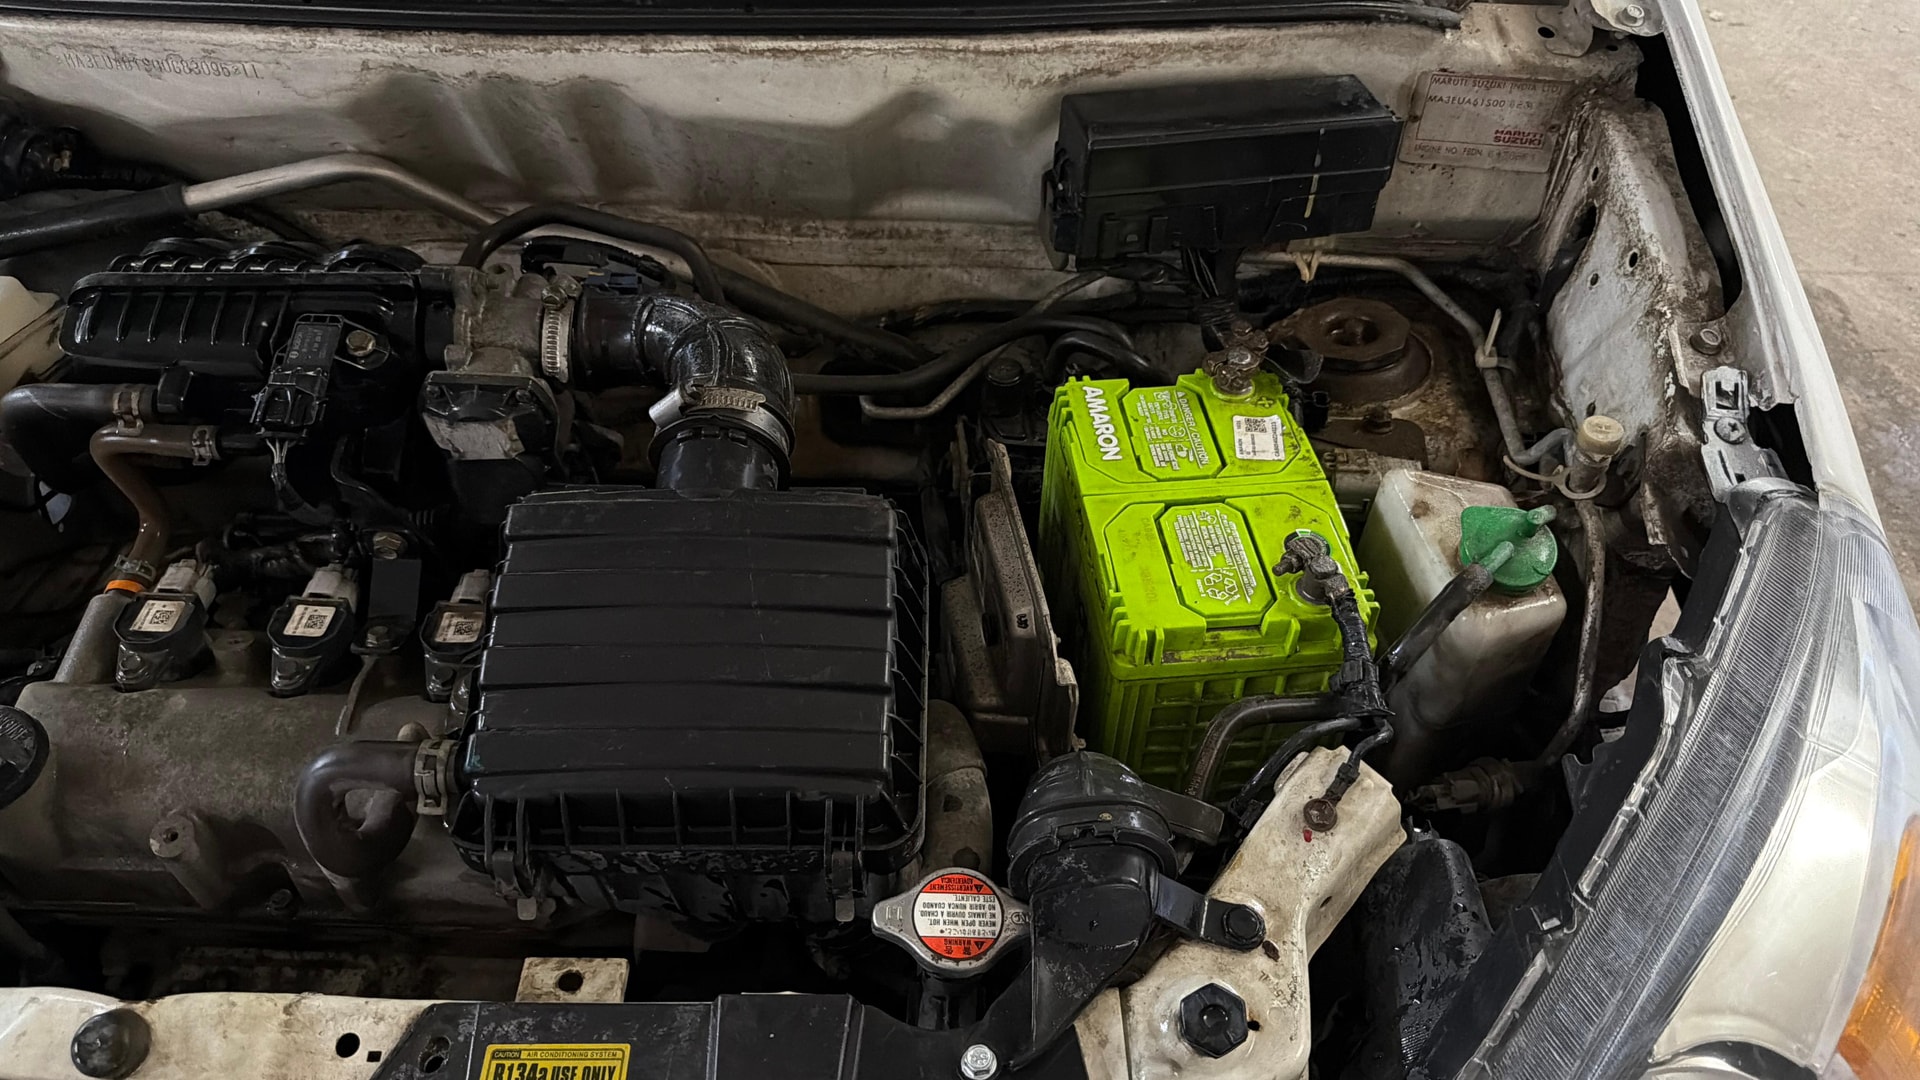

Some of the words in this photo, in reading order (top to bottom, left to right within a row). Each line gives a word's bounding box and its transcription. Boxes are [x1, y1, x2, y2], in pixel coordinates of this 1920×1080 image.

[1432, 77, 1467, 87] MARUTI
[1472, 79, 1506, 89] SUZUKI
[1494, 129, 1544, 138] MARUTI
[1493, 136, 1542, 146] SUZUKI
[1082, 385, 1123, 461] AMARON
[1178, 398, 1196, 427] DANGER
[1191, 432, 1209, 465] CAUTION
[551, 1065, 578, 1080] USE
[582, 1065, 617, 1080] ONLY
